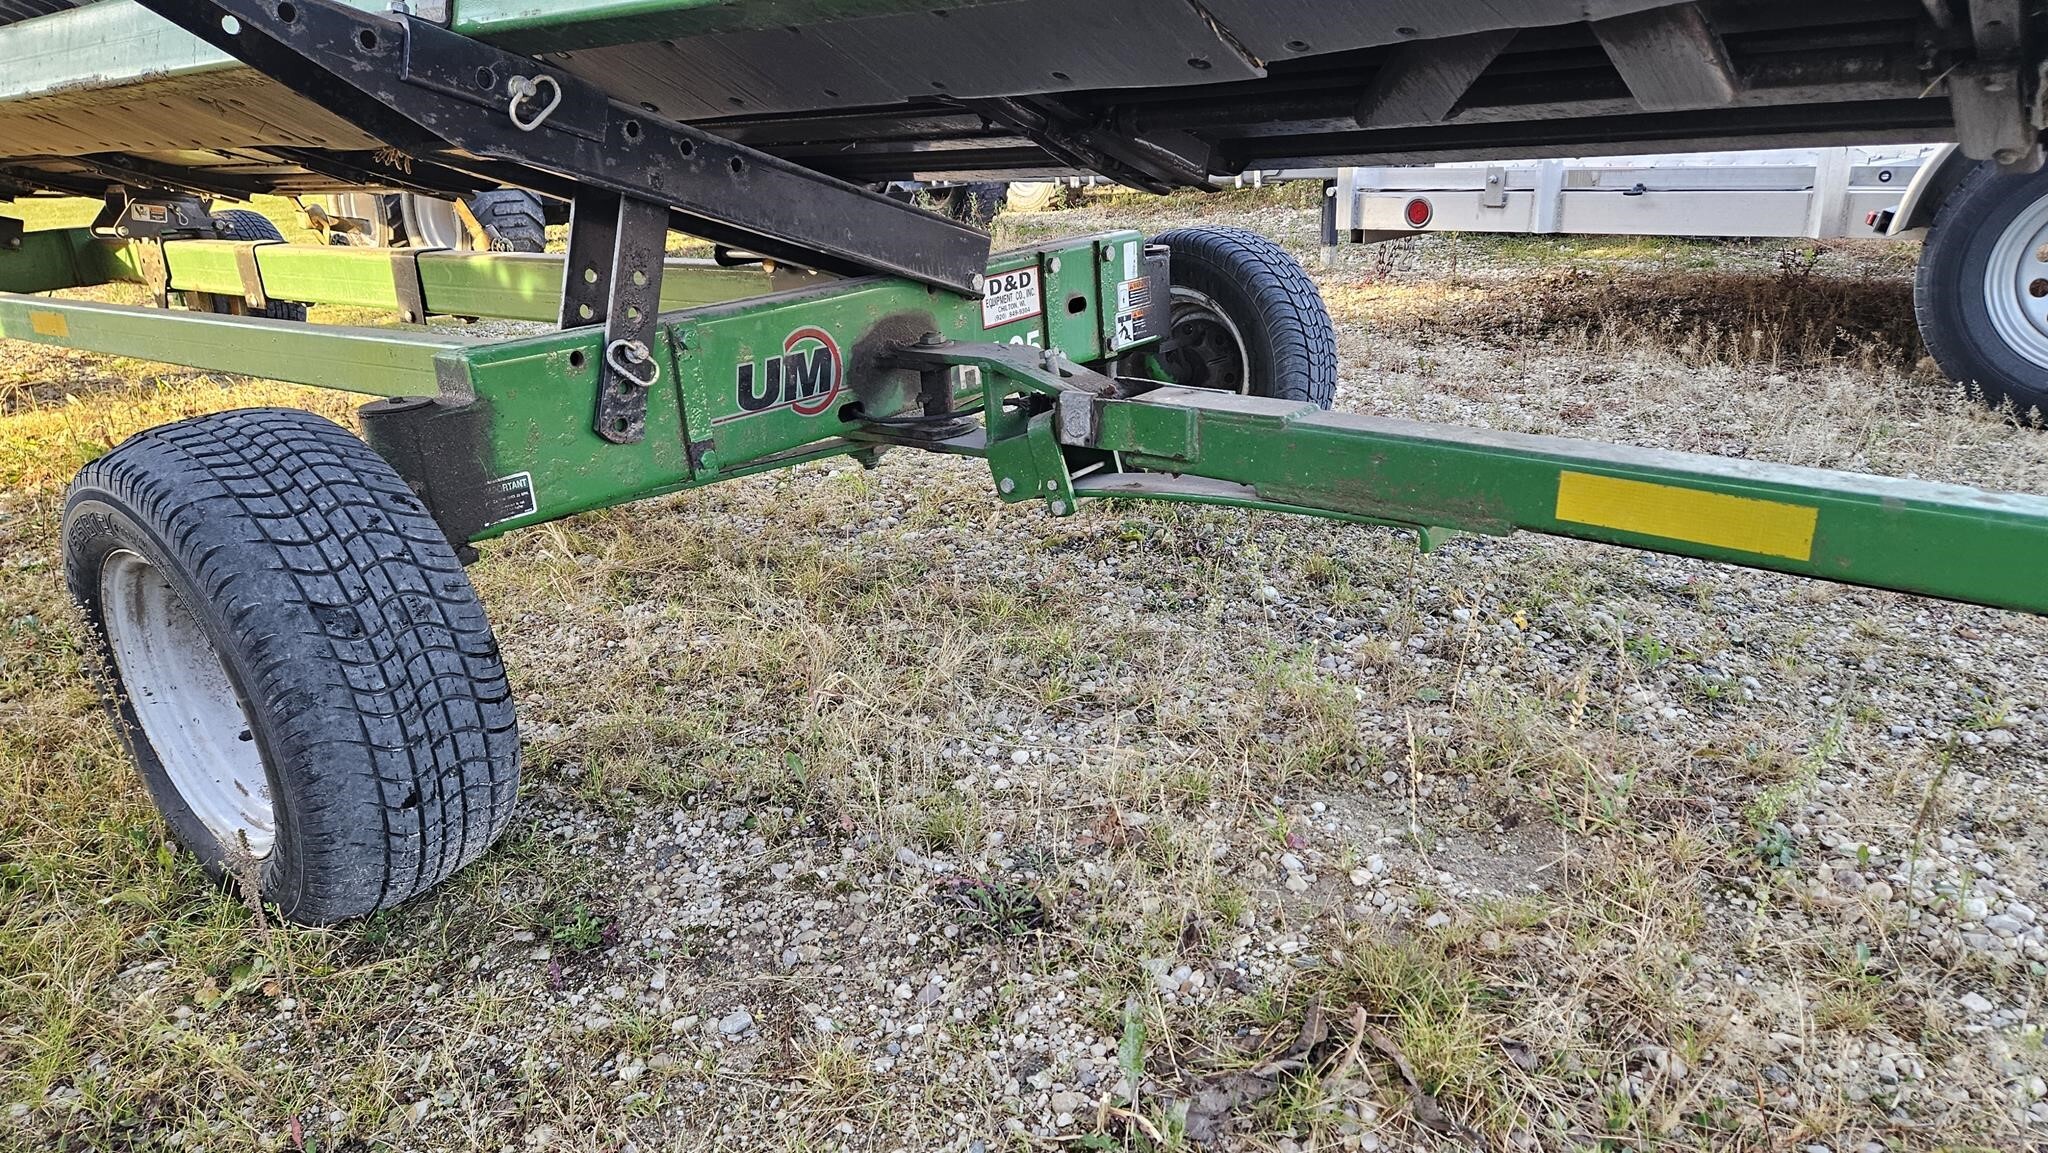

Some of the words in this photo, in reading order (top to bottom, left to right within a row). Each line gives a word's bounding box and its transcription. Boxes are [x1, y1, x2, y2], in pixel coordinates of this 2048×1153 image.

[989, 272, 1031, 296] D&D
[985, 292, 1013, 309] EQUIPMENT
[736, 345, 833, 412] UM
